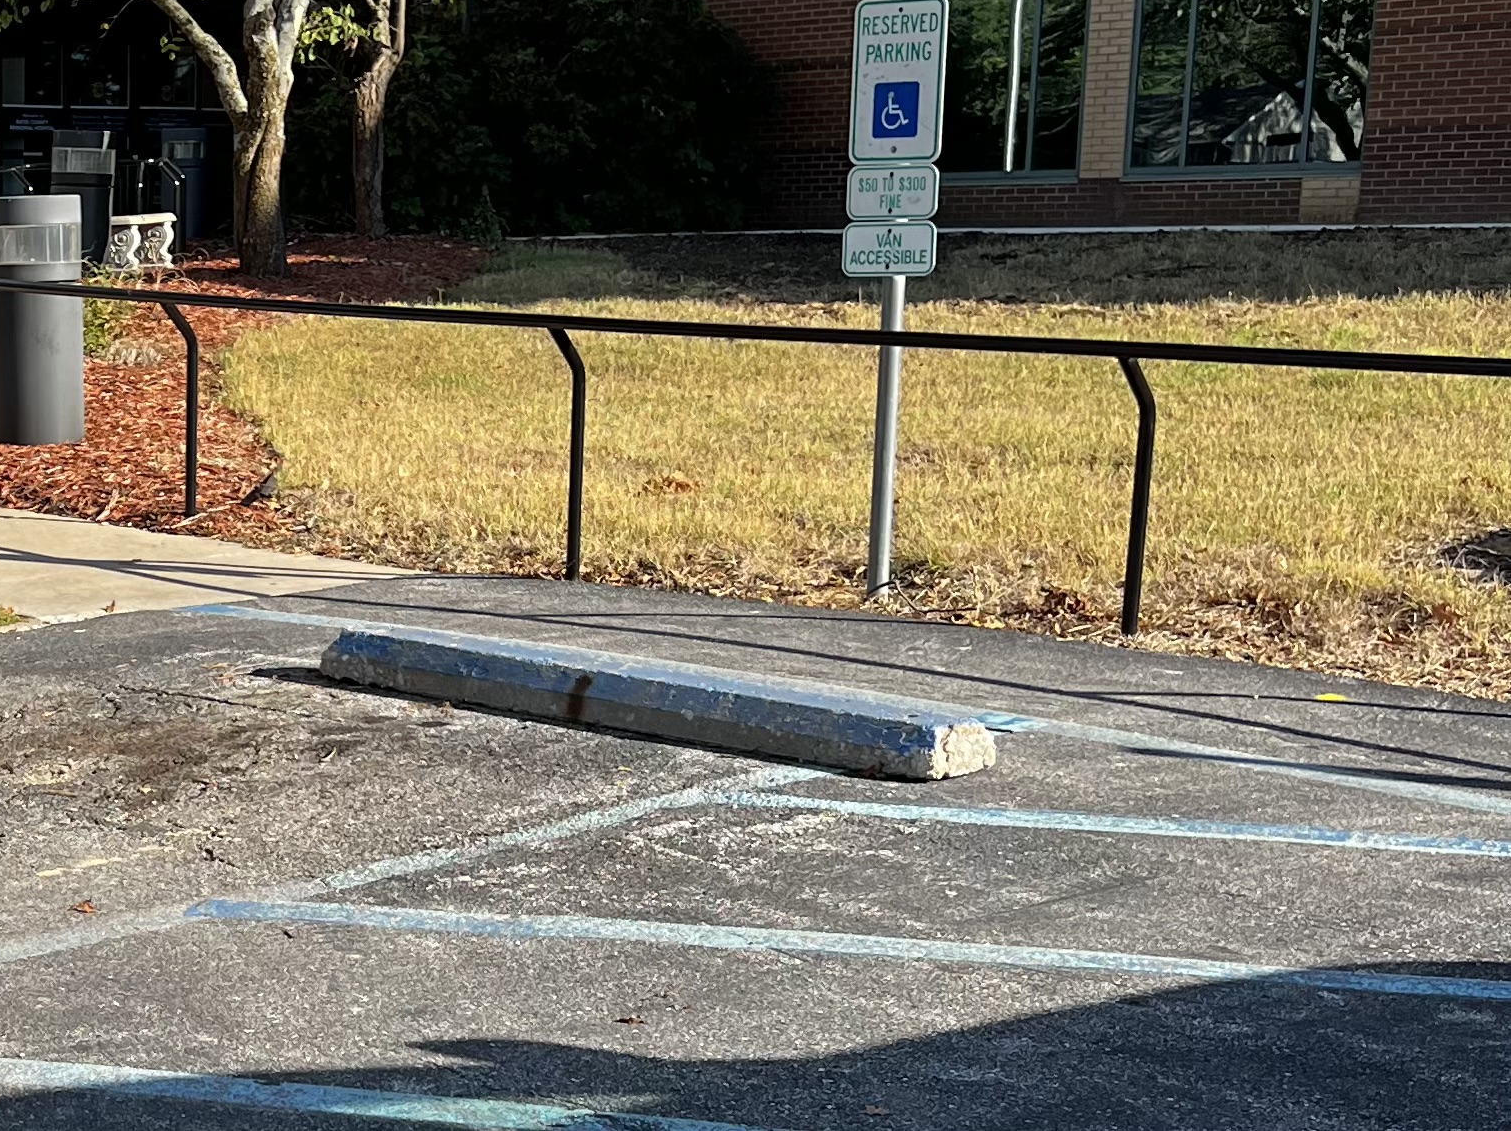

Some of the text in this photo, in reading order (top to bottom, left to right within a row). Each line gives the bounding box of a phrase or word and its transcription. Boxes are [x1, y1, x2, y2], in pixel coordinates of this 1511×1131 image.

[862, 12, 939, 36] RESERVED
[865, 41, 932, 65] PARKING
[858, 176, 926, 193] $50 TO $300
[879, 194, 902, 209] FINE
[876, 233, 902, 249] VAN
[849, 249, 927, 266] ACCESSIBLE
